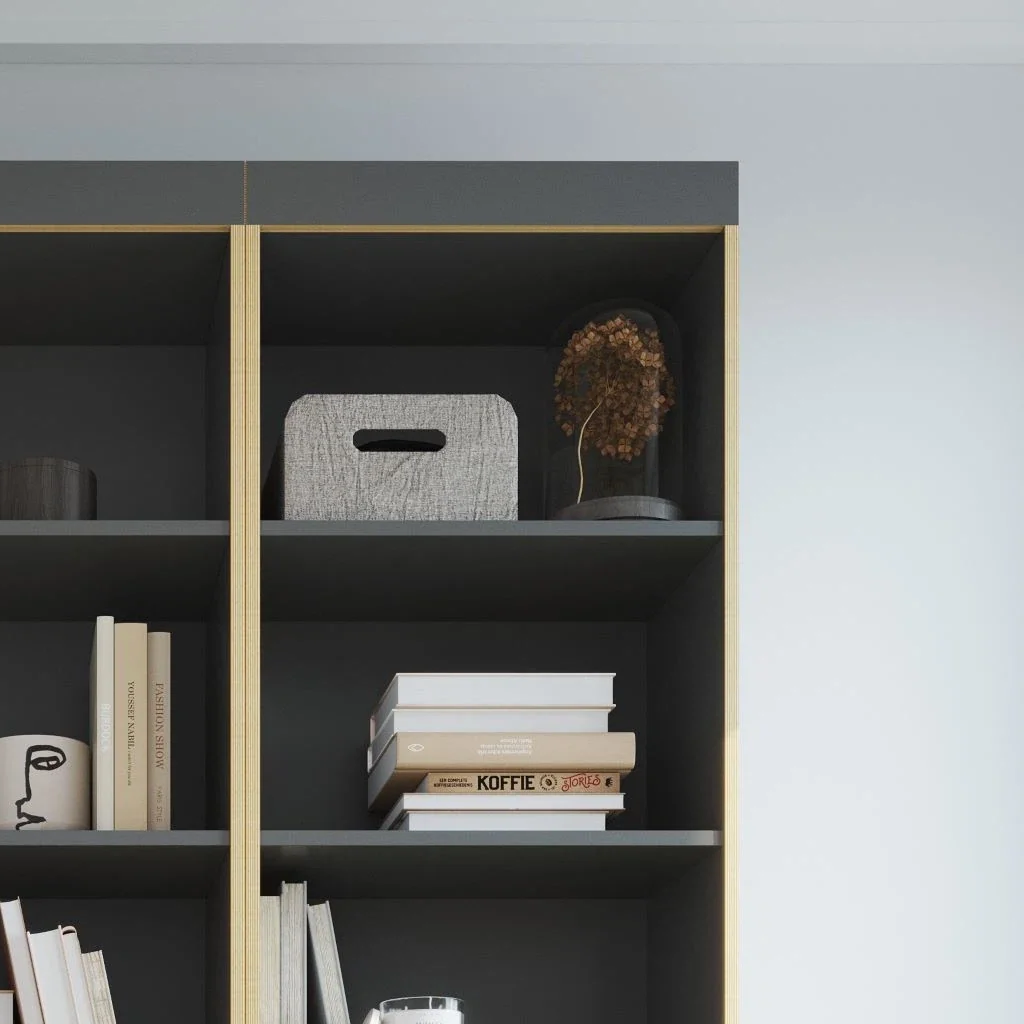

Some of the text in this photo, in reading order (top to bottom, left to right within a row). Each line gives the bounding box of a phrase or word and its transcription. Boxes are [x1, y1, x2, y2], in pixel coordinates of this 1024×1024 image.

[127, 681, 135, 720] YOUSSEF
[156, 683, 164, 732] FASHION
[127, 722, 135, 749] NABIL
[156, 735, 164, 769] SHOW
[477, 775, 535, 790] KOFFIE
[561, 773, 601, 792] STORIES
